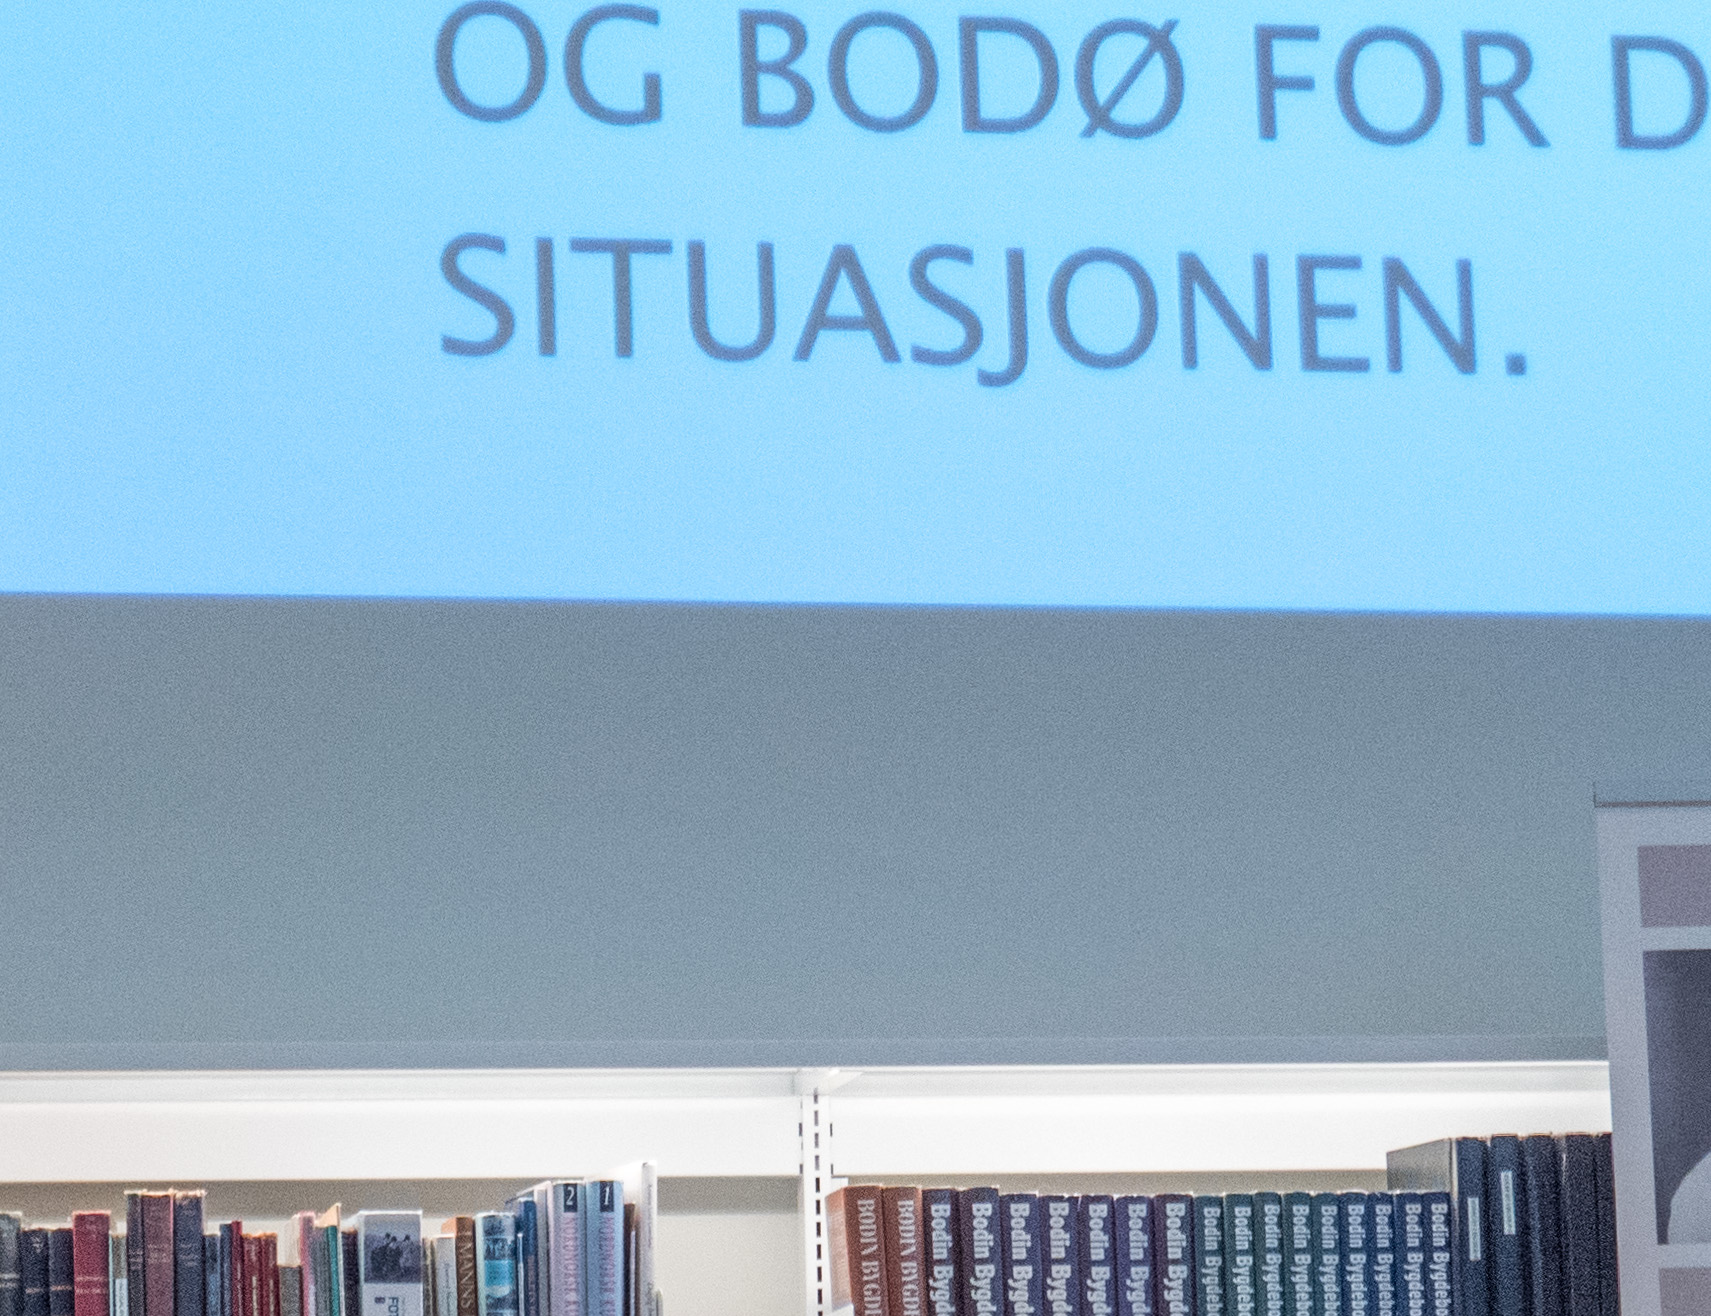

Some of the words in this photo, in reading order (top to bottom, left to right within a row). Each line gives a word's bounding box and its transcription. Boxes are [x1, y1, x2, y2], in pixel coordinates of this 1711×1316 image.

[434, 0, 664, 126] OG
[738, 9, 1187, 140] BODØ
[1254, 24, 1549, 148] FOR
[438, 232, 1528, 388] SITUASJONEN.
[857, 1200, 877, 1255] BODIN
[897, 1200, 915, 1256] BODIN
[931, 1204, 952, 1259] Bodin
[972, 1203, 994, 1258] Bodin
[1010, 1203, 1031, 1260] Bodin
[1050, 1202, 1070, 1258] Bodin
[1089, 1204, 1109, 1260] Bodin
[1128, 1204, 1147, 1260] Bodin
[1166, 1203, 1186, 1259] Bodin
[1204, 1207, 1221, 1250] Bodin
[1234, 1207, 1251, 1250] Bodin
[1264, 1204, 1281, 1248] Bodin
[1293, 1205, 1310, 1248] Bodin
[1321, 1206, 1338, 1248] Bodin
[1348, 1205, 1365, 1248] Bodin
[1375, 1205, 1393, 1248] Bodin
[1406, 1204, 1423, 1247] Bodin
[1431, 1203, 1449, 1246] Bodin
